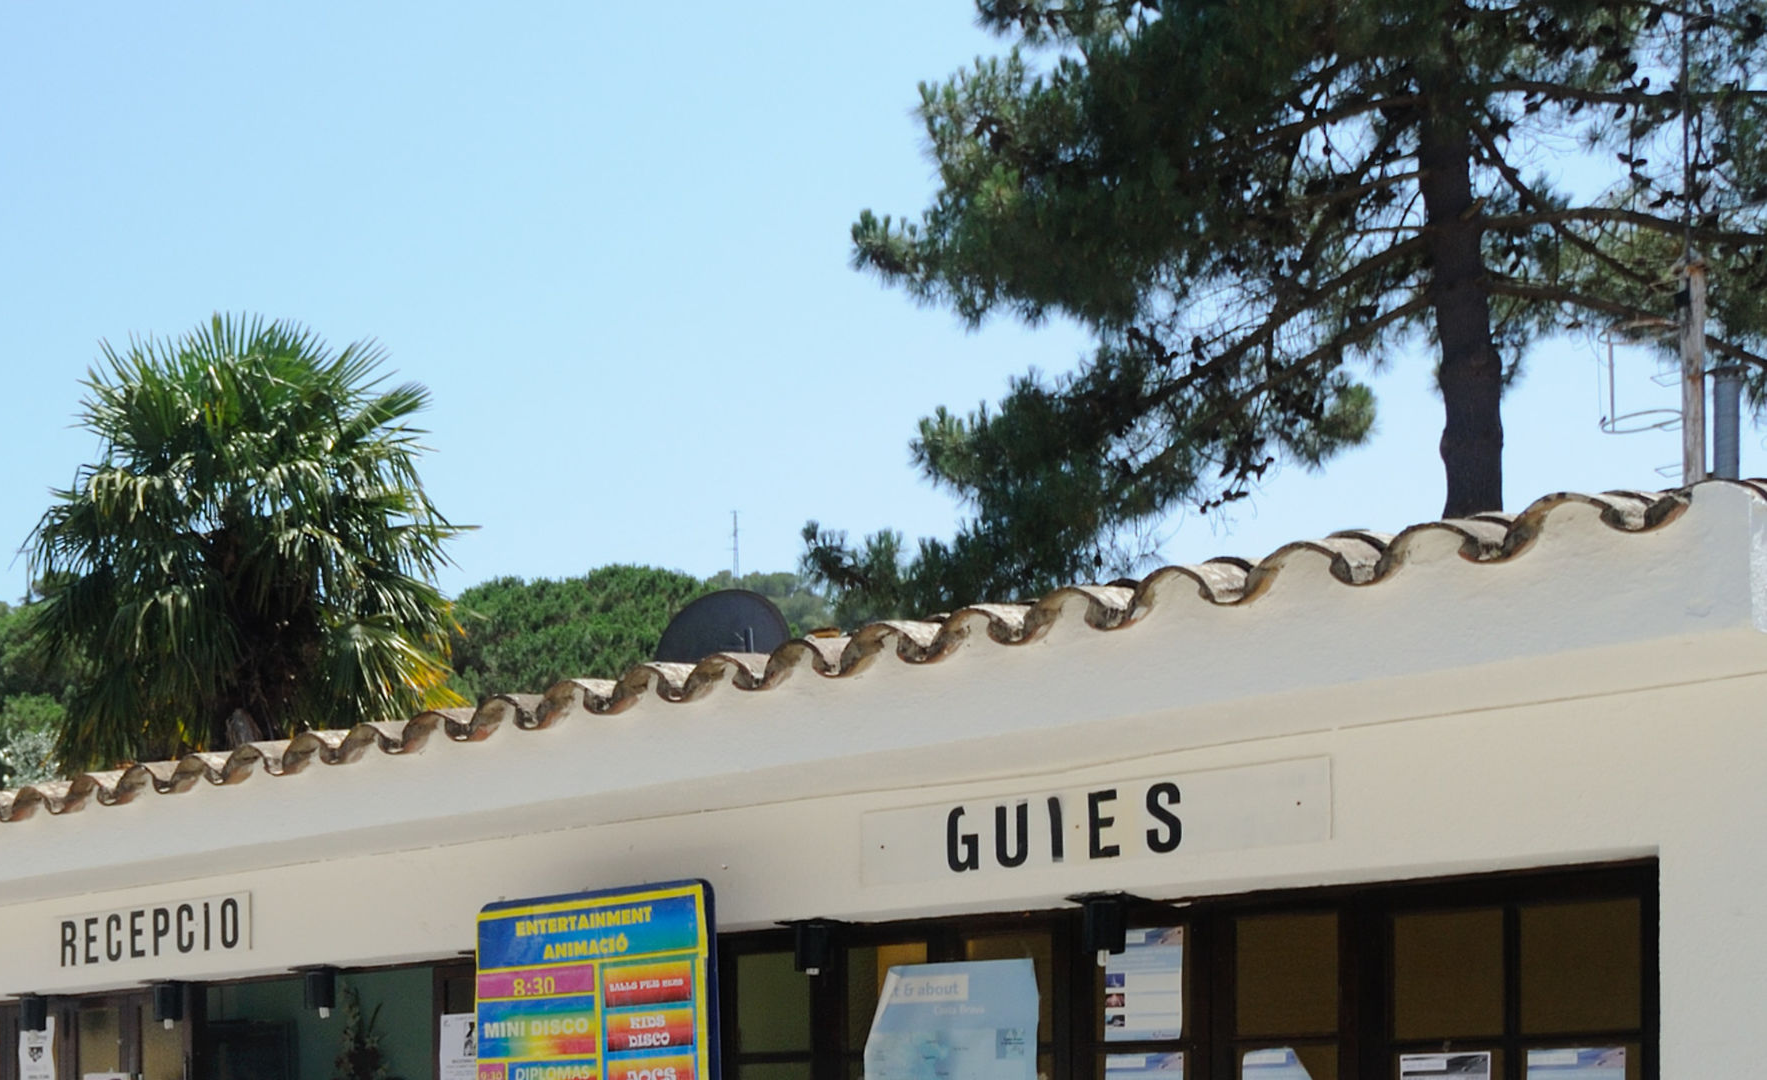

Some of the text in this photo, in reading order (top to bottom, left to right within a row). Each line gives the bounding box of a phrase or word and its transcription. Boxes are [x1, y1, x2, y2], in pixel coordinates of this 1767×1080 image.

[946, 782, 1182, 873] GUIES
[515, 906, 653, 937] ENTERTAINMENT
[60, 897, 239, 968] RECEPCIO
[543, 932, 629, 960] ANIMACIÓ
[513, 976, 555, 996] 8:30
[917, 981, 959, 996] about
[484, 1017, 589, 1038] MINI DISCO
[629, 1014, 666, 1030] KIDS
[628, 1032, 671, 1048] DISCO
